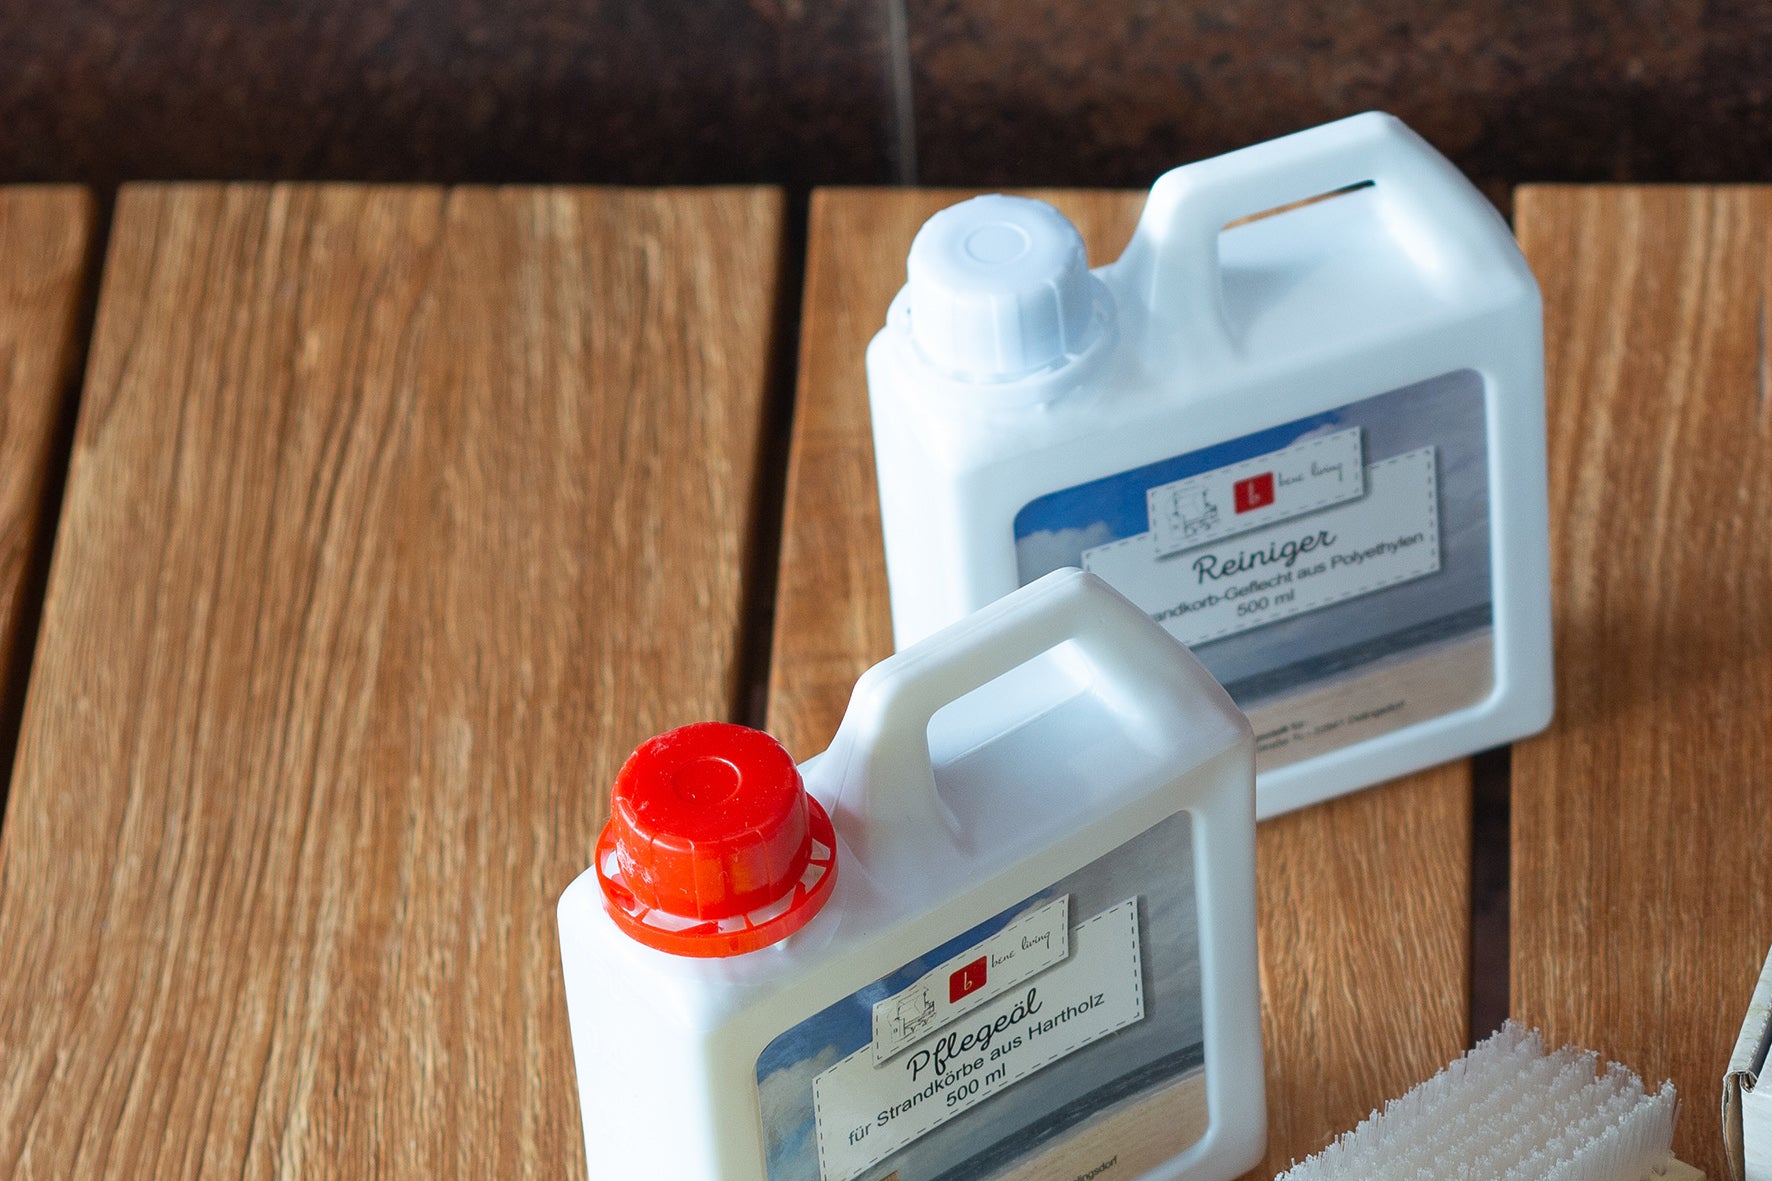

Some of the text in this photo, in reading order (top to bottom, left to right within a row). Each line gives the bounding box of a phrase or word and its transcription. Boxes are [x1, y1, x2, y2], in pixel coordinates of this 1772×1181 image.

[1192, 530, 1337, 585] Reiniger
[1153, 570, 1293, 622] andkorb-Geflecht
[1236, 588, 1295, 617] 500 ml
[906, 987, 1043, 1082] Pflegeöl
[848, 992, 1105, 1146] für Strandkörbe aus Hartholz
[946, 1062, 1006, 1108] 500 ml
